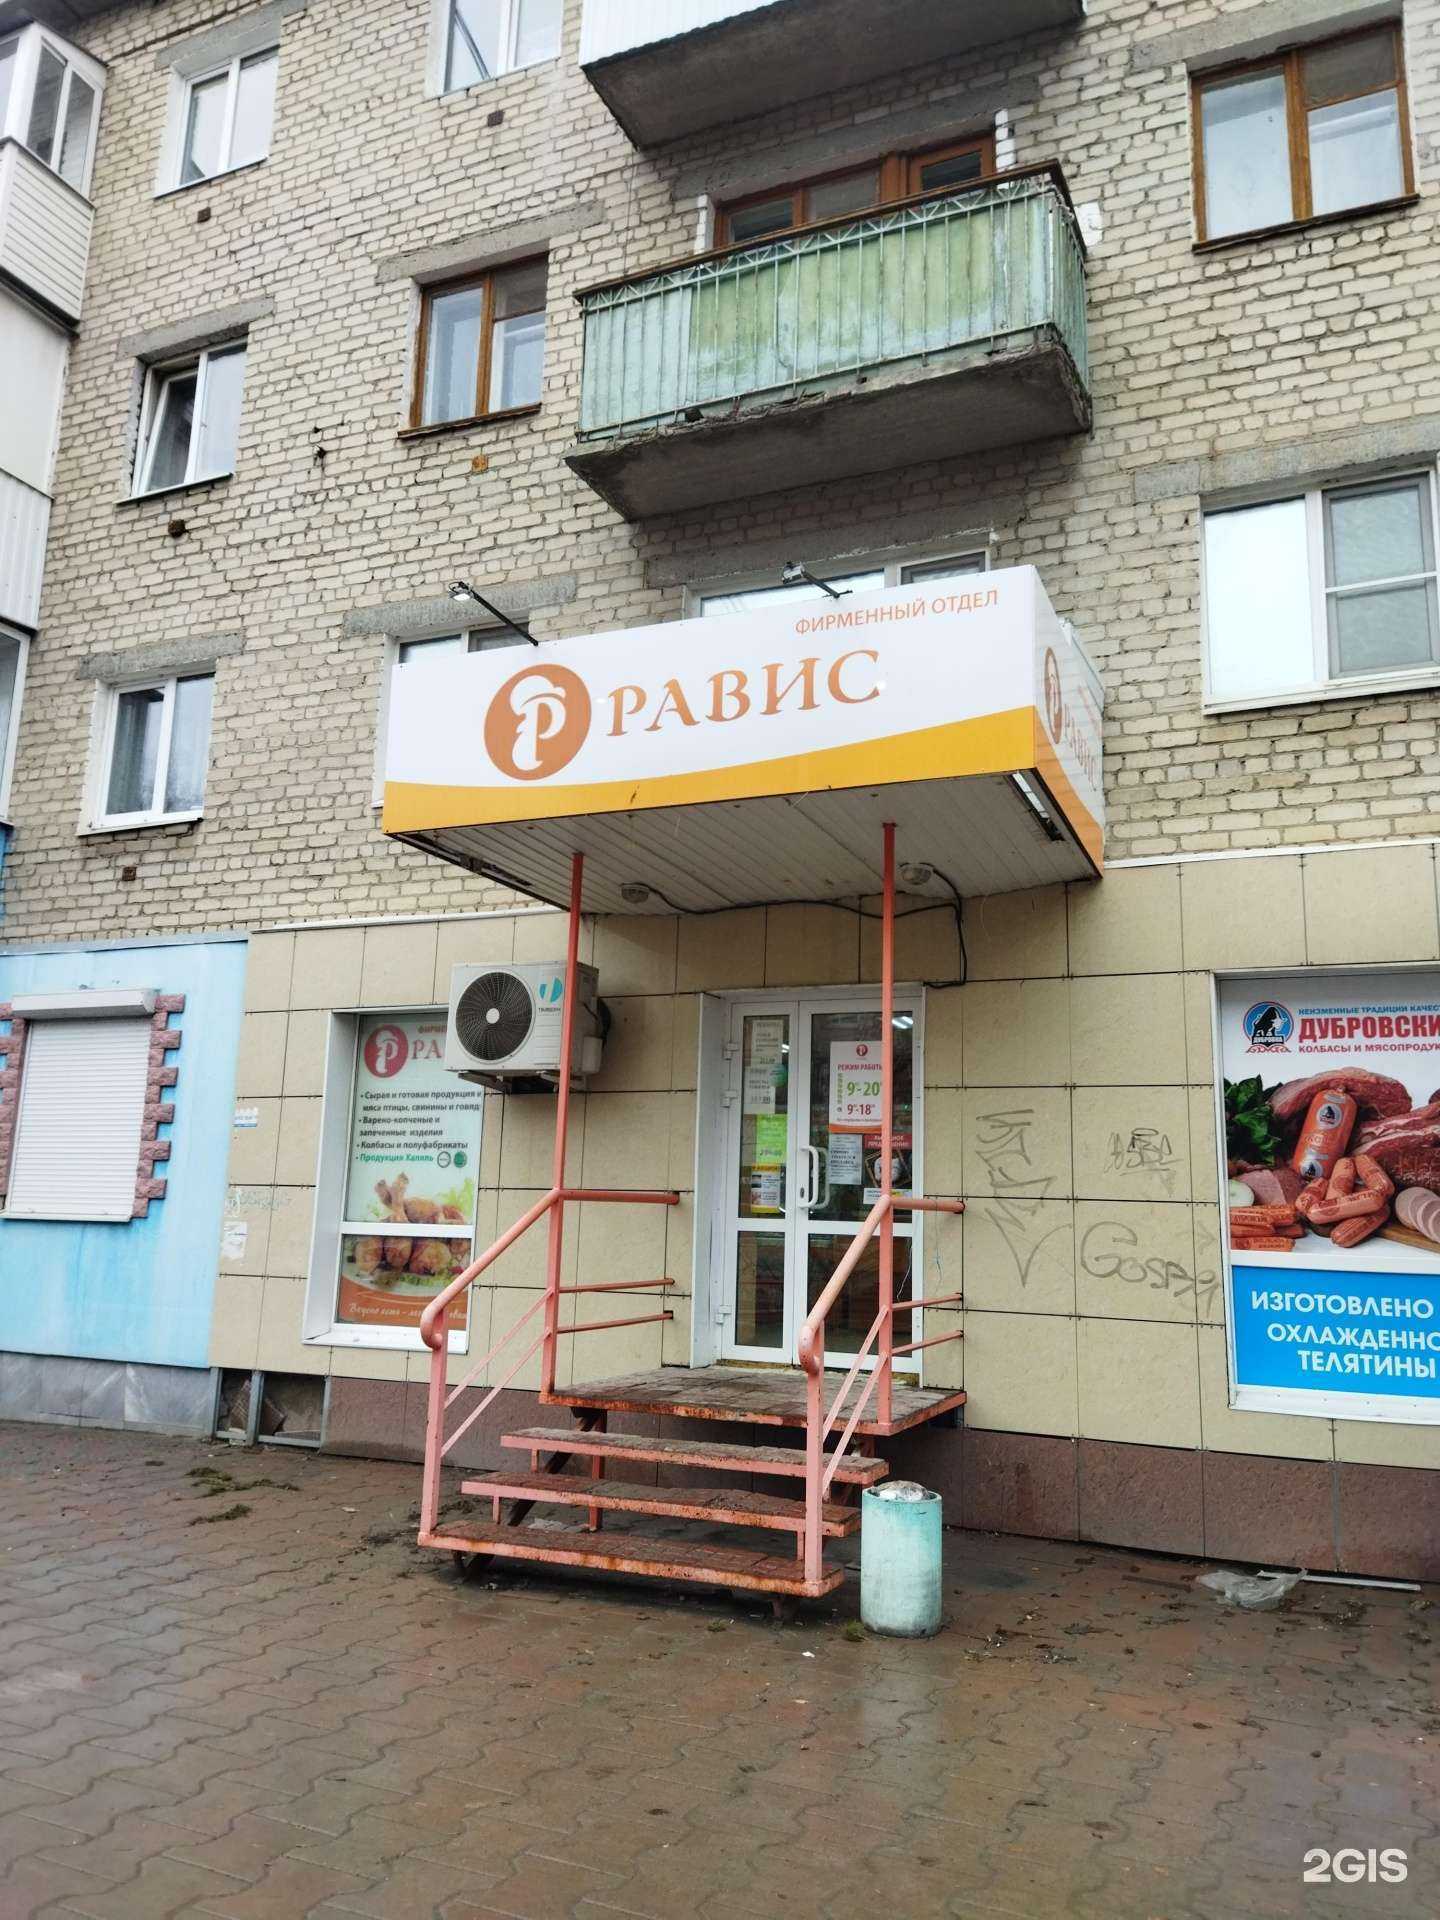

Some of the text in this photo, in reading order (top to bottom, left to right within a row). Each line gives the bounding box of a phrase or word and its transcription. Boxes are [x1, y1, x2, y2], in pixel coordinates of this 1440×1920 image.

[795, 589, 999, 635] ФИРМЕННЫЙ ОТДЕЛ
[605, 649, 881, 738] РАВИС
[1298, 1006, 1359, 1015] НЕИЗМЕННЫЕ
[1362, 1004, 1407, 1014] ТРАДИЦИИ
[1299, 1044, 1351, 1054] КОЛБАСЫ
[1354, 1045, 1362, 1053] И
[364, 1091, 389, 1100] Сырая
[398, 1090, 429, 1100] готовая
[431, 1091, 475, 1102] продукция
[412, 1103, 448, 1111] свинины
[409, 1129, 443, 1138] изделия
[361, 1140, 395, 1149] Колбасы
[403, 1140, 469, 1151] полуфабрикаты
[360, 1153, 405, 1164] Продукция
[1251, 1290, 1434, 1319] ИЗГОТОВЛЕНО
[1297, 1350, 1436, 1379] ТЕЛЯТИНЫ
